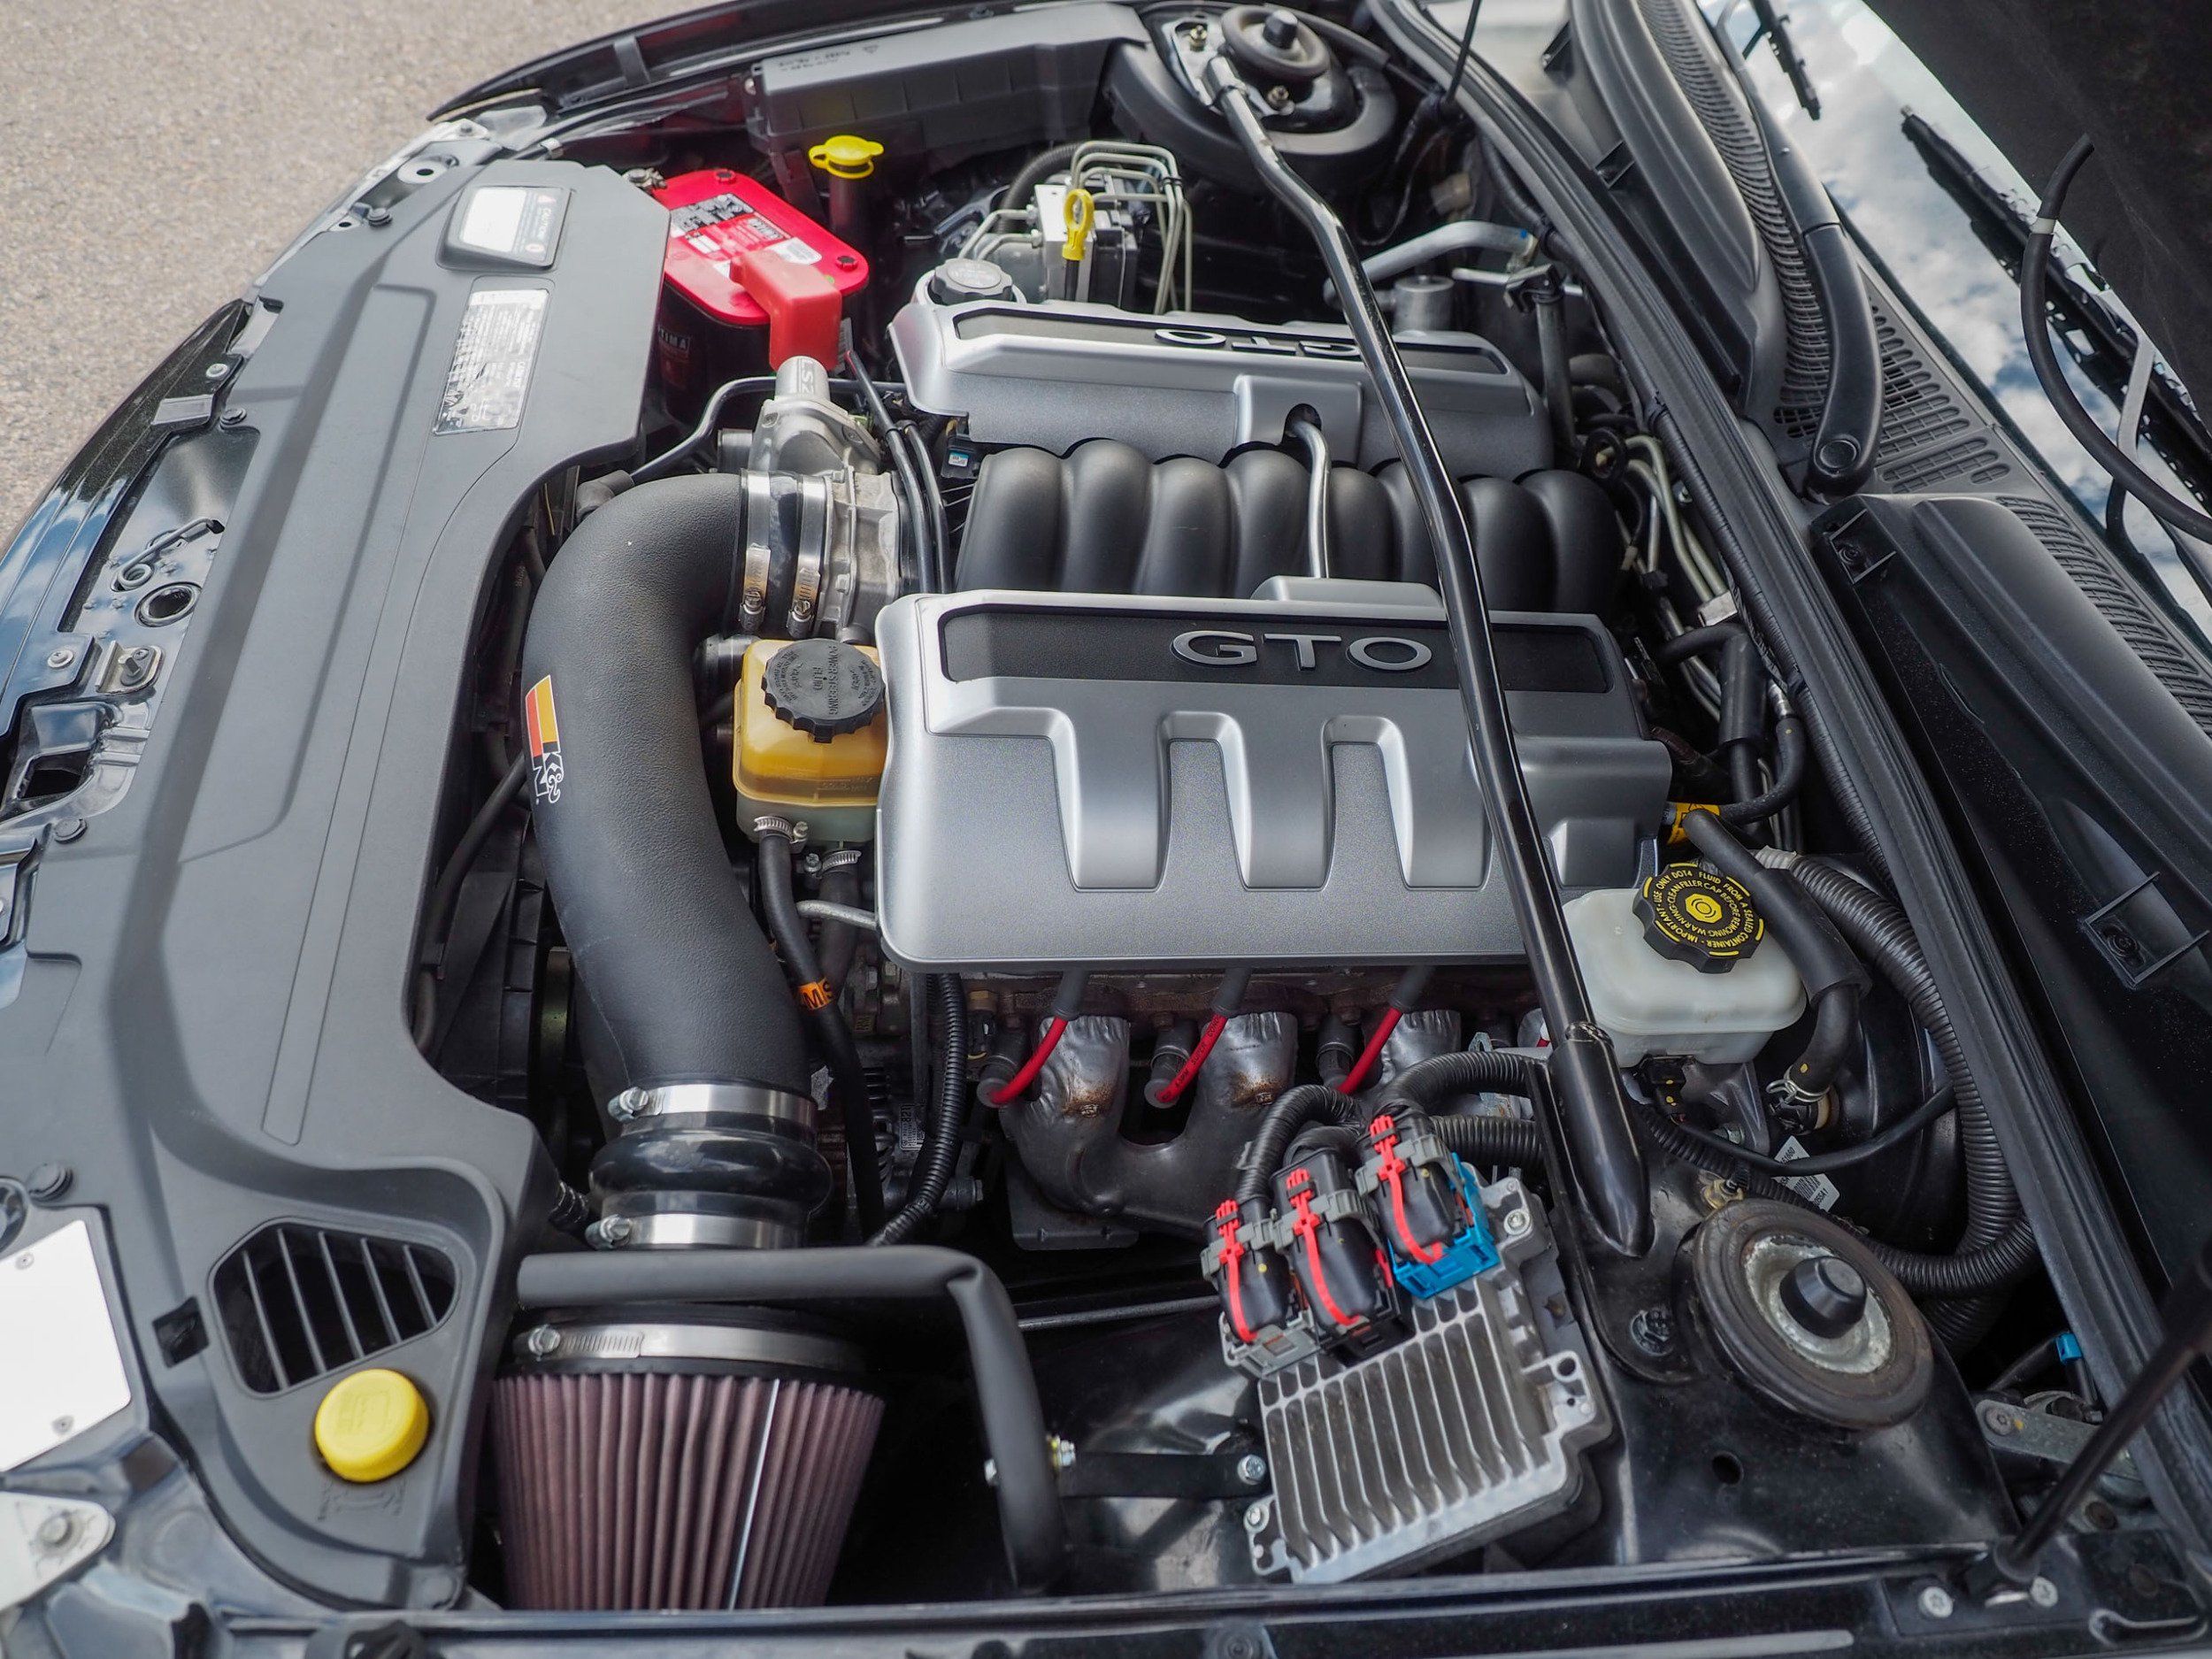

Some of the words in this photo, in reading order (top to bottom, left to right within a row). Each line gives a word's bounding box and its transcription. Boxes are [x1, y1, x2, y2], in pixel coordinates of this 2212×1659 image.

[1155, 328, 1360, 356] GTO
[1172, 630, 1432, 671] GTO
[813, 667, 823, 690] FLUID
[533, 741, 565, 803] K&N
[1656, 876, 1671, 890] ONLY
[1679, 880, 1702, 892] FILLER
[1699, 872, 1721, 884] FLUID
[1703, 883, 1722, 894] CAP
[1653, 890, 1663, 902] USE
[1724, 883, 1743, 901] FROM
[1720, 893, 1740, 918] BEFORE
[1656, 908, 1698, 943] IMPORTANT
[1709, 917, 1740, 938] REMOVING
[1744, 910, 1754, 933] SEALED
[1707, 933, 1748, 949] CONTAINER
